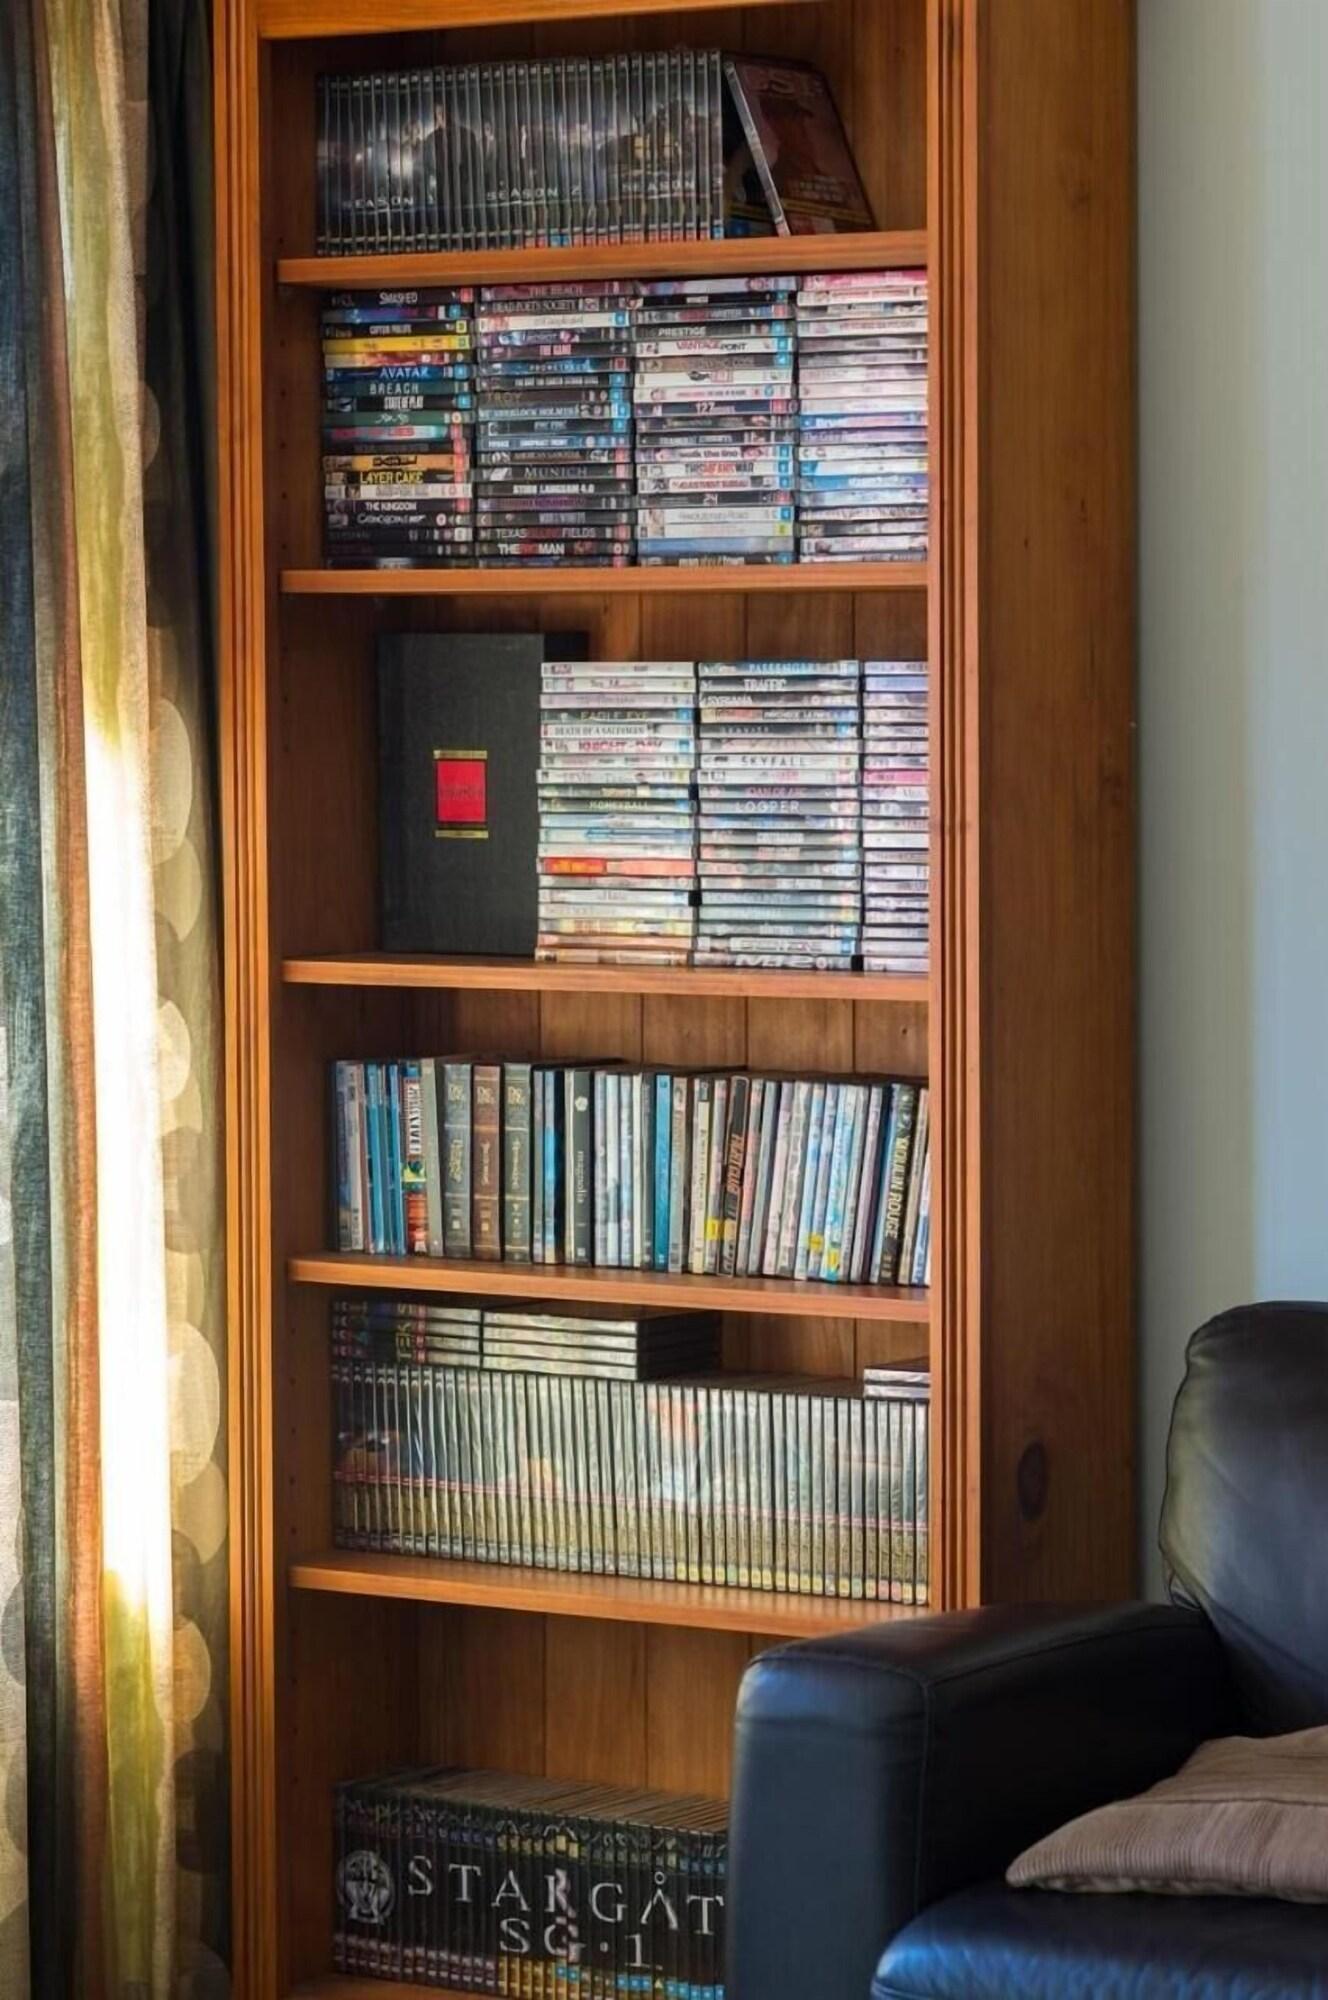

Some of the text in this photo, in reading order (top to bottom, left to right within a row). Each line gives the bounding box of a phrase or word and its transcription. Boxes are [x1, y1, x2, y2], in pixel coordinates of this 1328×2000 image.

[486, 186, 559, 202] SEASON
[657, 326, 706, 337] PRESTIGE
[676, 339, 748, 351] VANTAGE POINT
[379, 366, 431, 379] AVATAR
[368, 382, 420, 395] BREACH
[695, 402, 715, 414] 127
[703, 449, 719, 457] the
[360, 471, 424, 484] LAYER CAKE
[524, 467, 588, 478] MUNICH
[365, 502, 417, 512] THE KINGDOM
[496, 529, 528, 539] TEXAS
[561, 528, 597, 538] FIELDS
[497, 544, 522, 555] THE
[743, 678, 787, 691] TRAFFIC
[580, 711, 649, 721] EAGLE EYE
[555, 727, 582, 736] DEATH
[740, 755, 806, 766] SKYFALL
[735, 801, 800, 813] LOOPER
[726, 1133, 744, 1195] FIGHT CLUB
[576, 1150, 588, 1204] magnolia
[884, 1136, 911, 1239] MOULIN ROUGE
